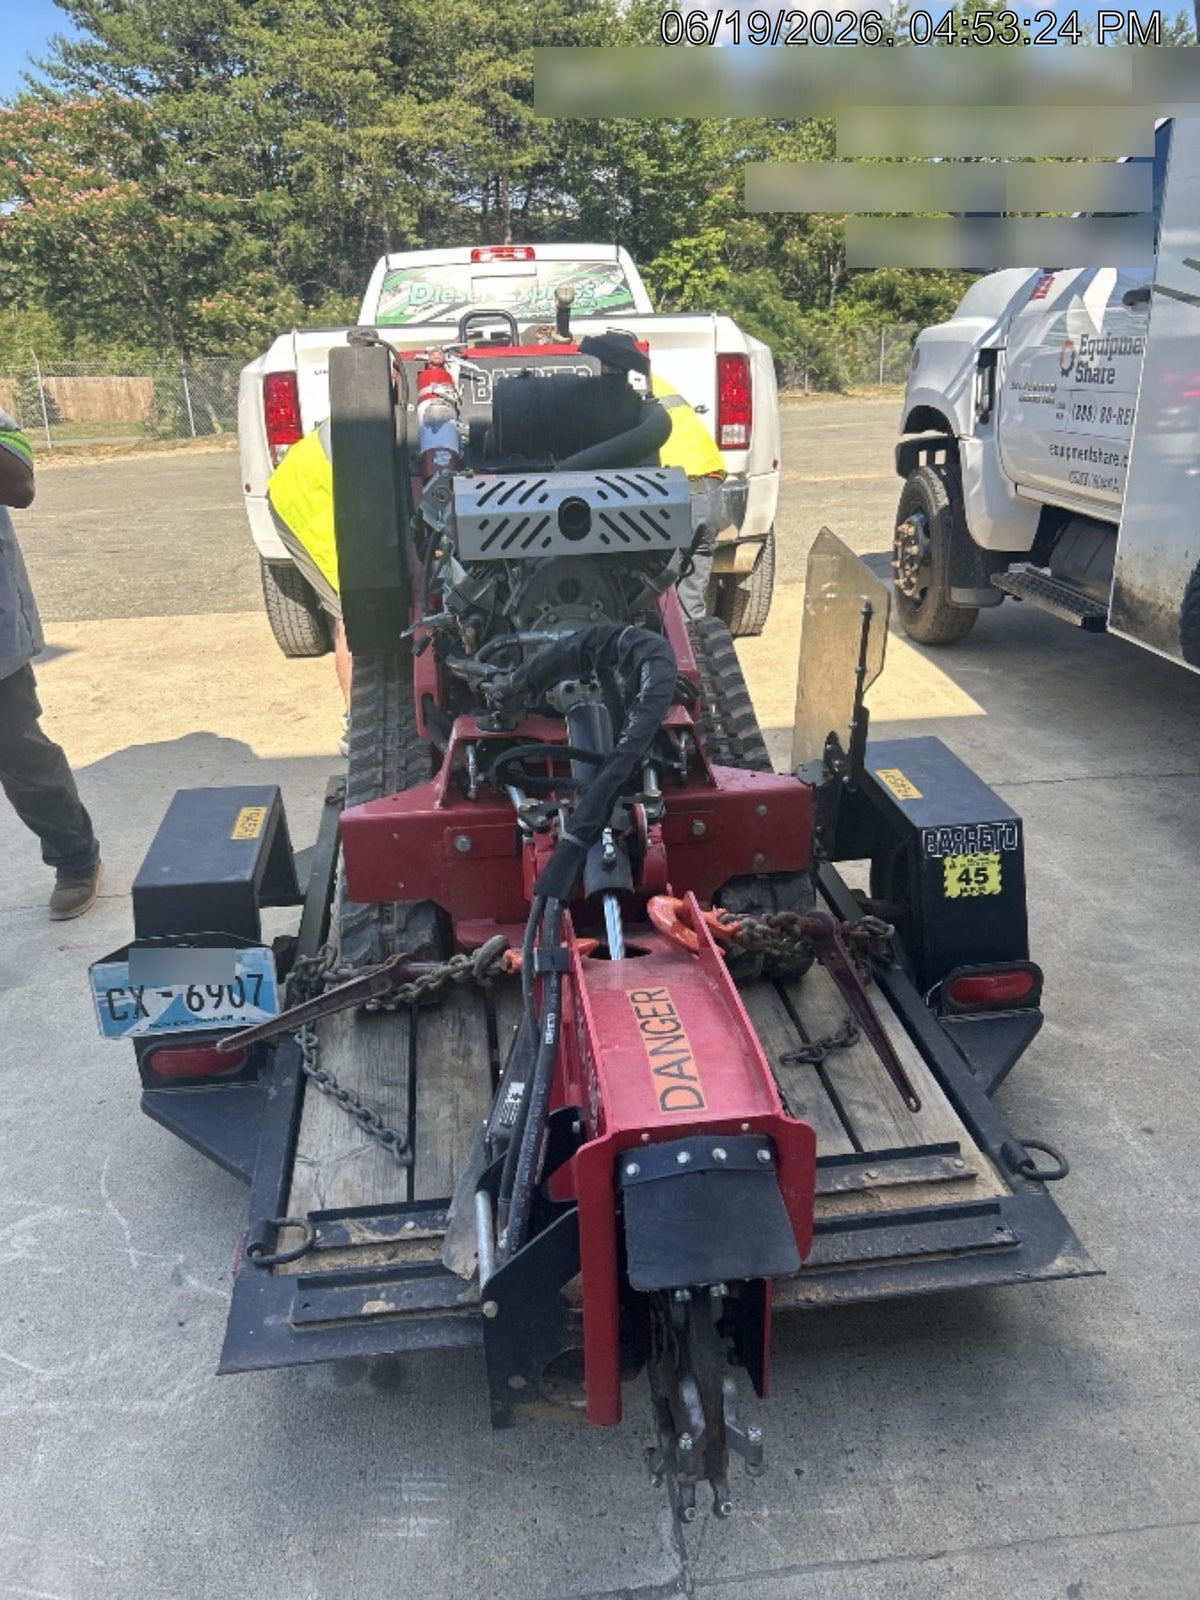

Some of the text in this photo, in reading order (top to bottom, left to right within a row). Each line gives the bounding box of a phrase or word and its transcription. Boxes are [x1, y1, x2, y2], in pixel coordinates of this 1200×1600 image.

[1075, 361, 1116, 384] Share
[922, 823, 1018, 858] BARRETO
[957, 868, 989, 885] 45
[630, 988, 705, 1112] DANGER
